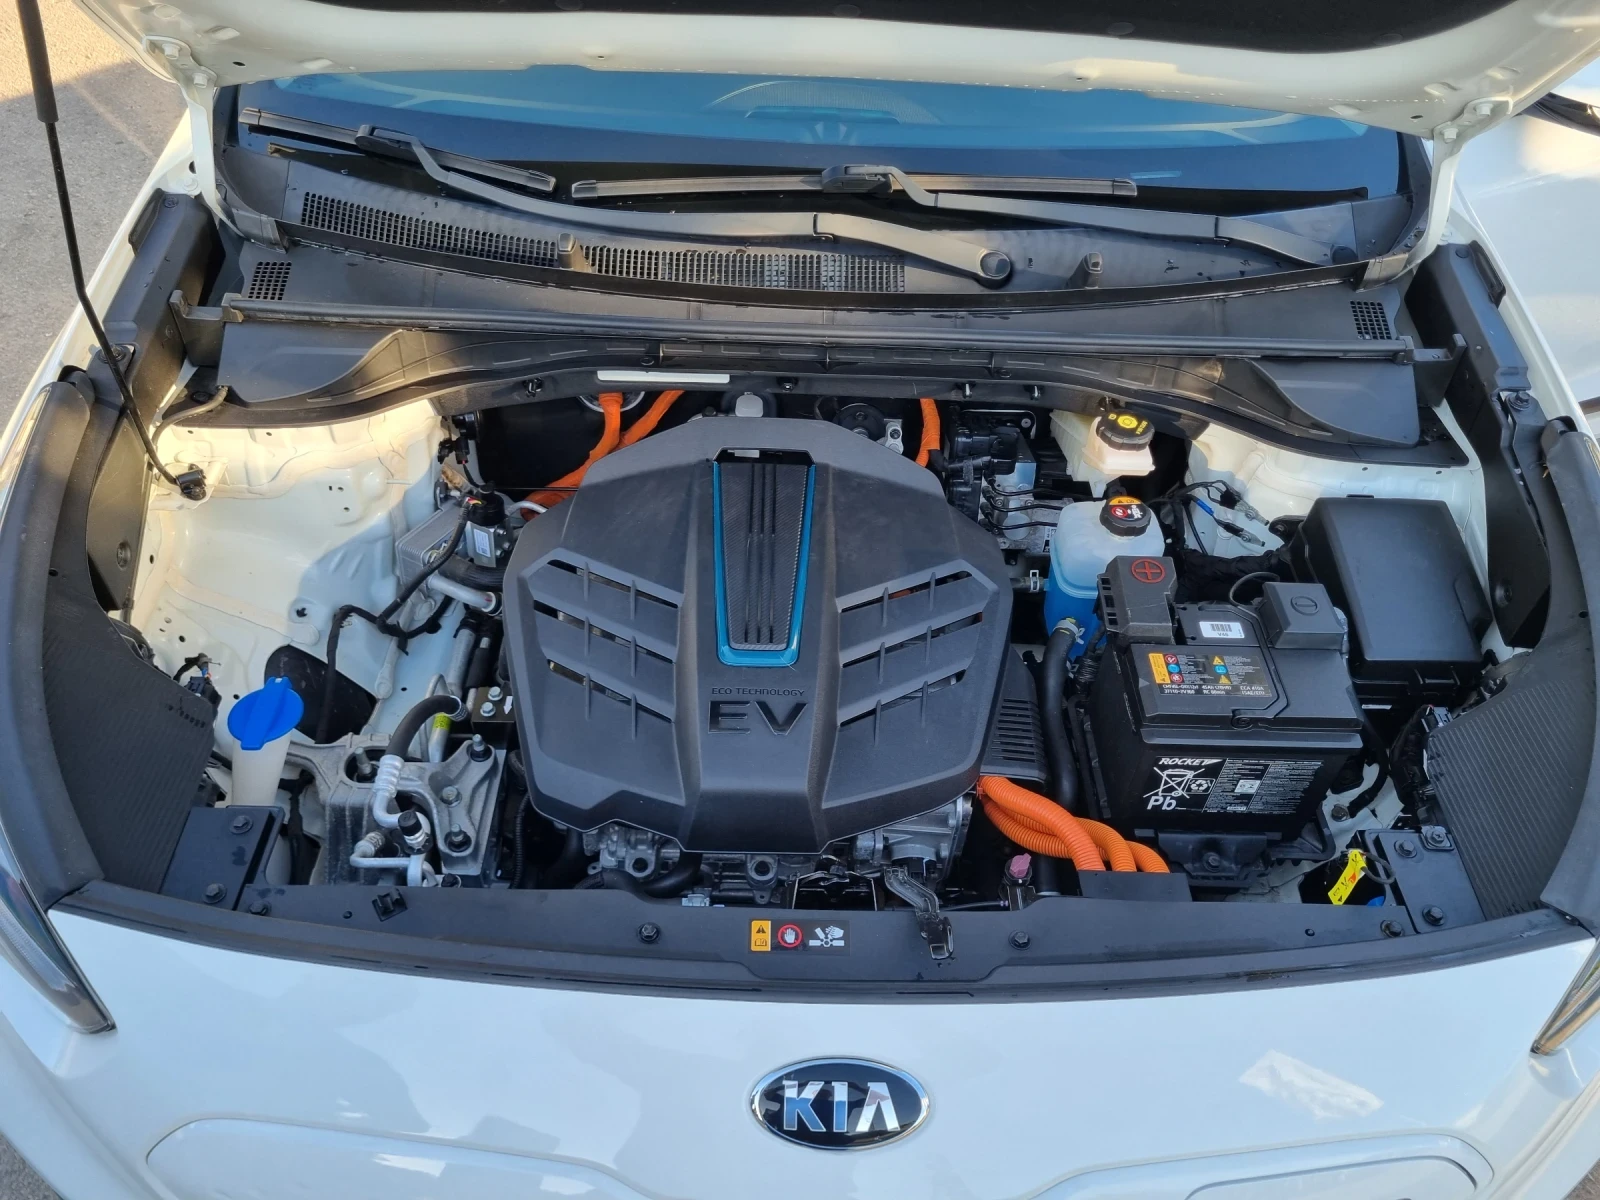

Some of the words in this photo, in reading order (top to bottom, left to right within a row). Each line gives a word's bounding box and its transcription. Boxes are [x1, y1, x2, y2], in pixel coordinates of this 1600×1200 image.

[711, 687, 732, 695] ECO
[736, 688, 805, 696] TECHNOLOGY
[708, 700, 808, 736] EV
[1158, 758, 1222, 766] ROCKET
[1146, 796, 1177, 810] Pb
[782, 1080, 901, 1132] KIA
